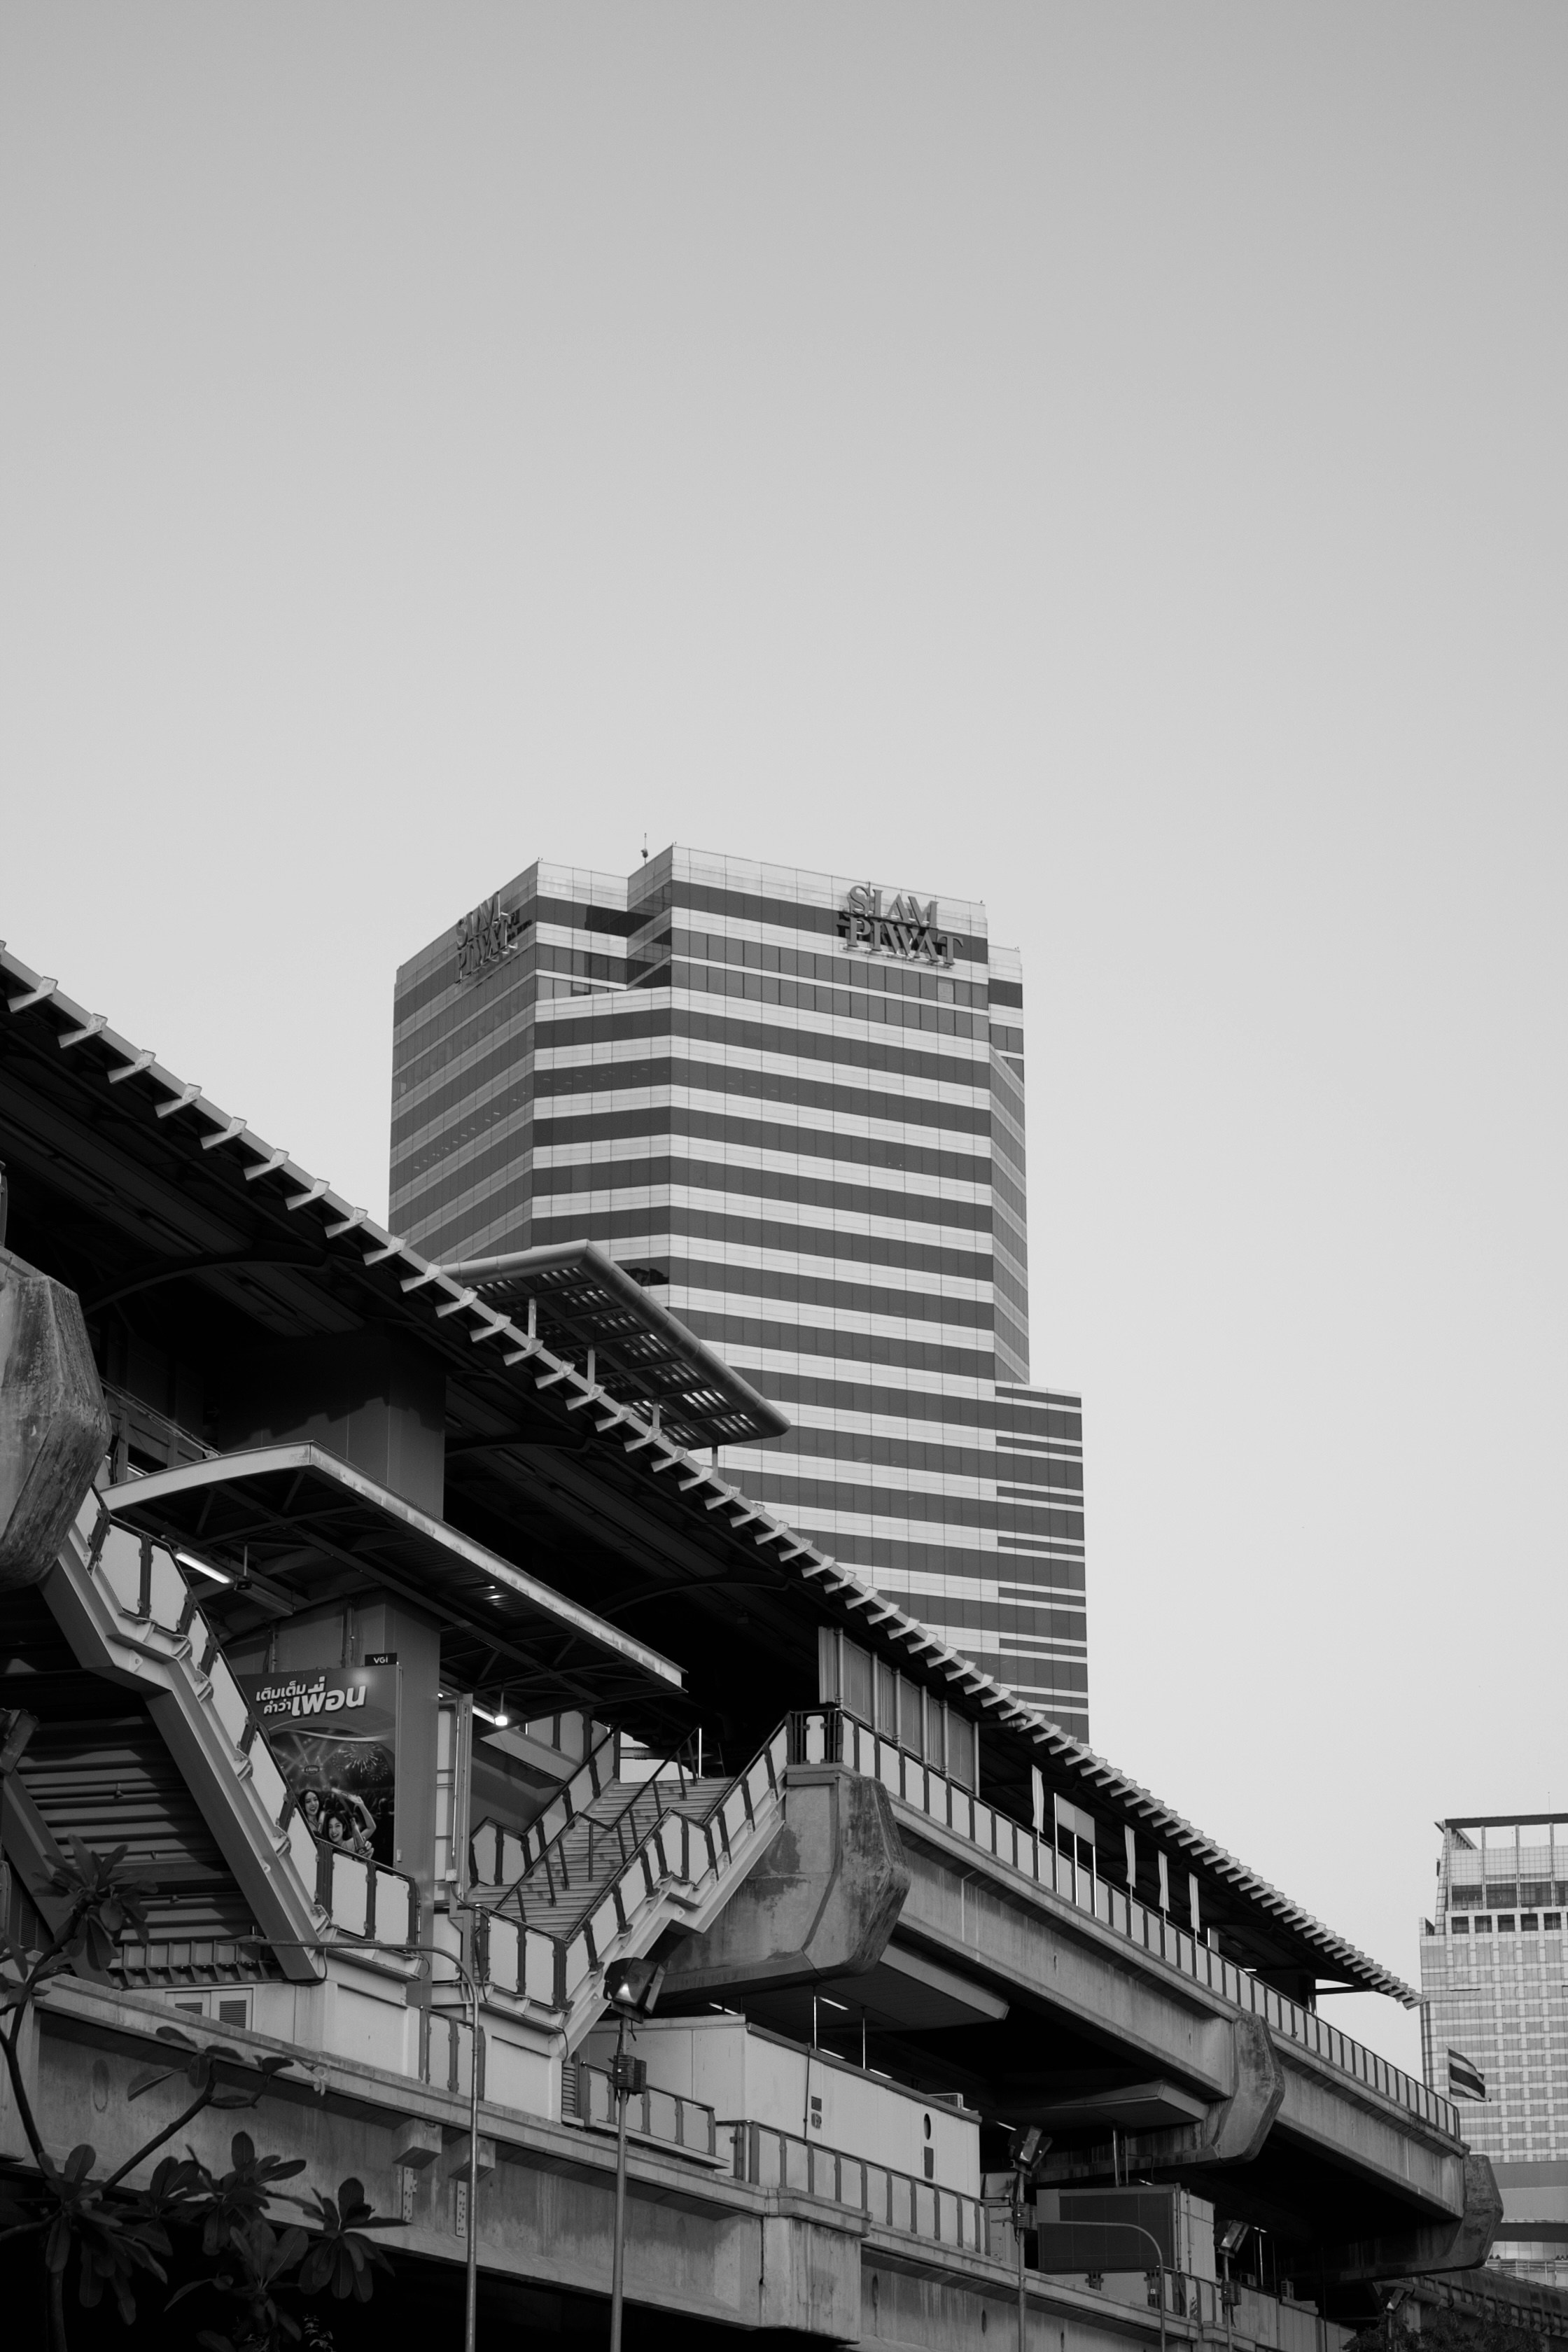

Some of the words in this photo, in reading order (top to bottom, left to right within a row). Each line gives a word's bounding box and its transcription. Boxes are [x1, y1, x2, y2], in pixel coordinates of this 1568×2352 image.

[848, 885, 939, 930] SIAM
[846, 916, 964, 965] PIWAT
[256, 1680, 306, 1702] เติมเต็ม
